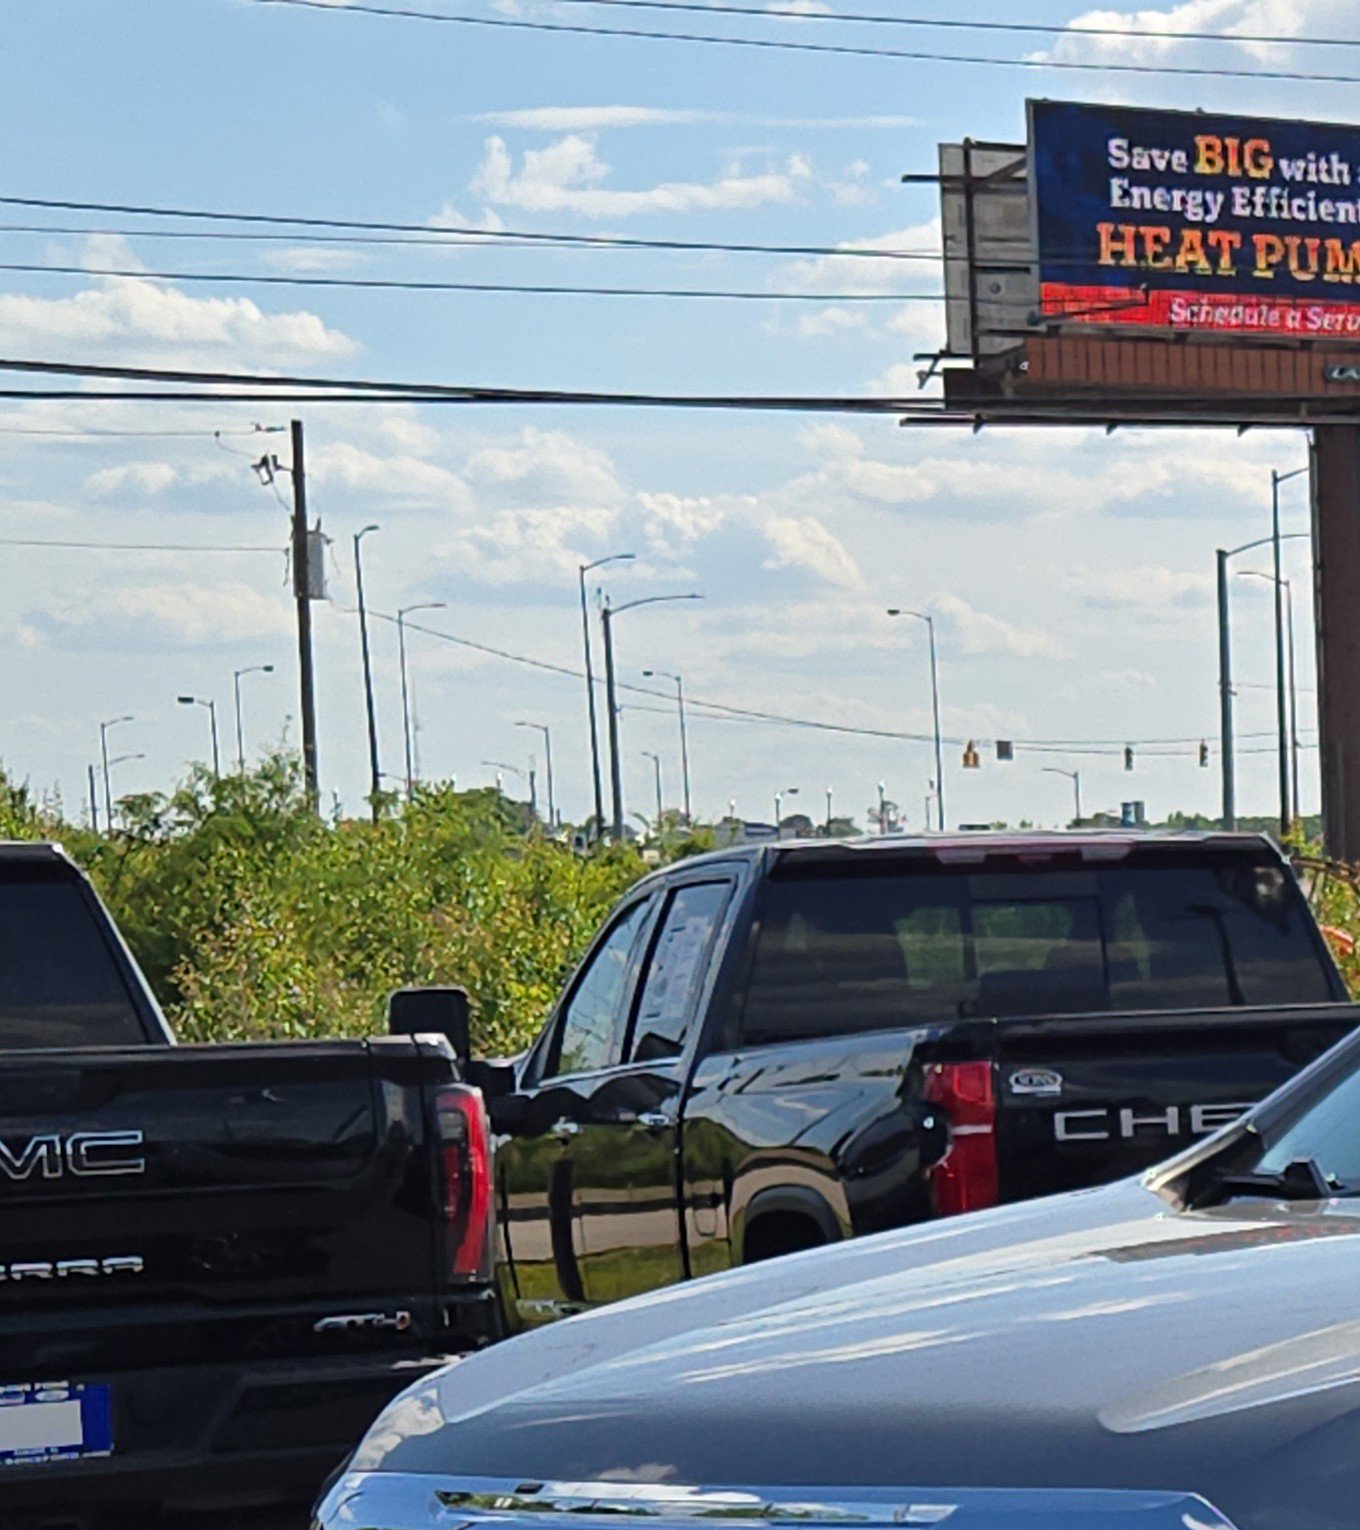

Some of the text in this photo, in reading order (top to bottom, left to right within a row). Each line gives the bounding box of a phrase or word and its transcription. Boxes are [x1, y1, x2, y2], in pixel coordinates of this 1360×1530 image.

[1107, 138, 1188, 174] Save
[1193, 134, 1274, 179] BIG
[1278, 151, 1351, 186] with
[1109, 177, 1225, 223] Energy
[1095, 222, 1242, 277] HEAT
[1170, 297, 1279, 327] Schedule
[1286, 311, 1301, 329] a
